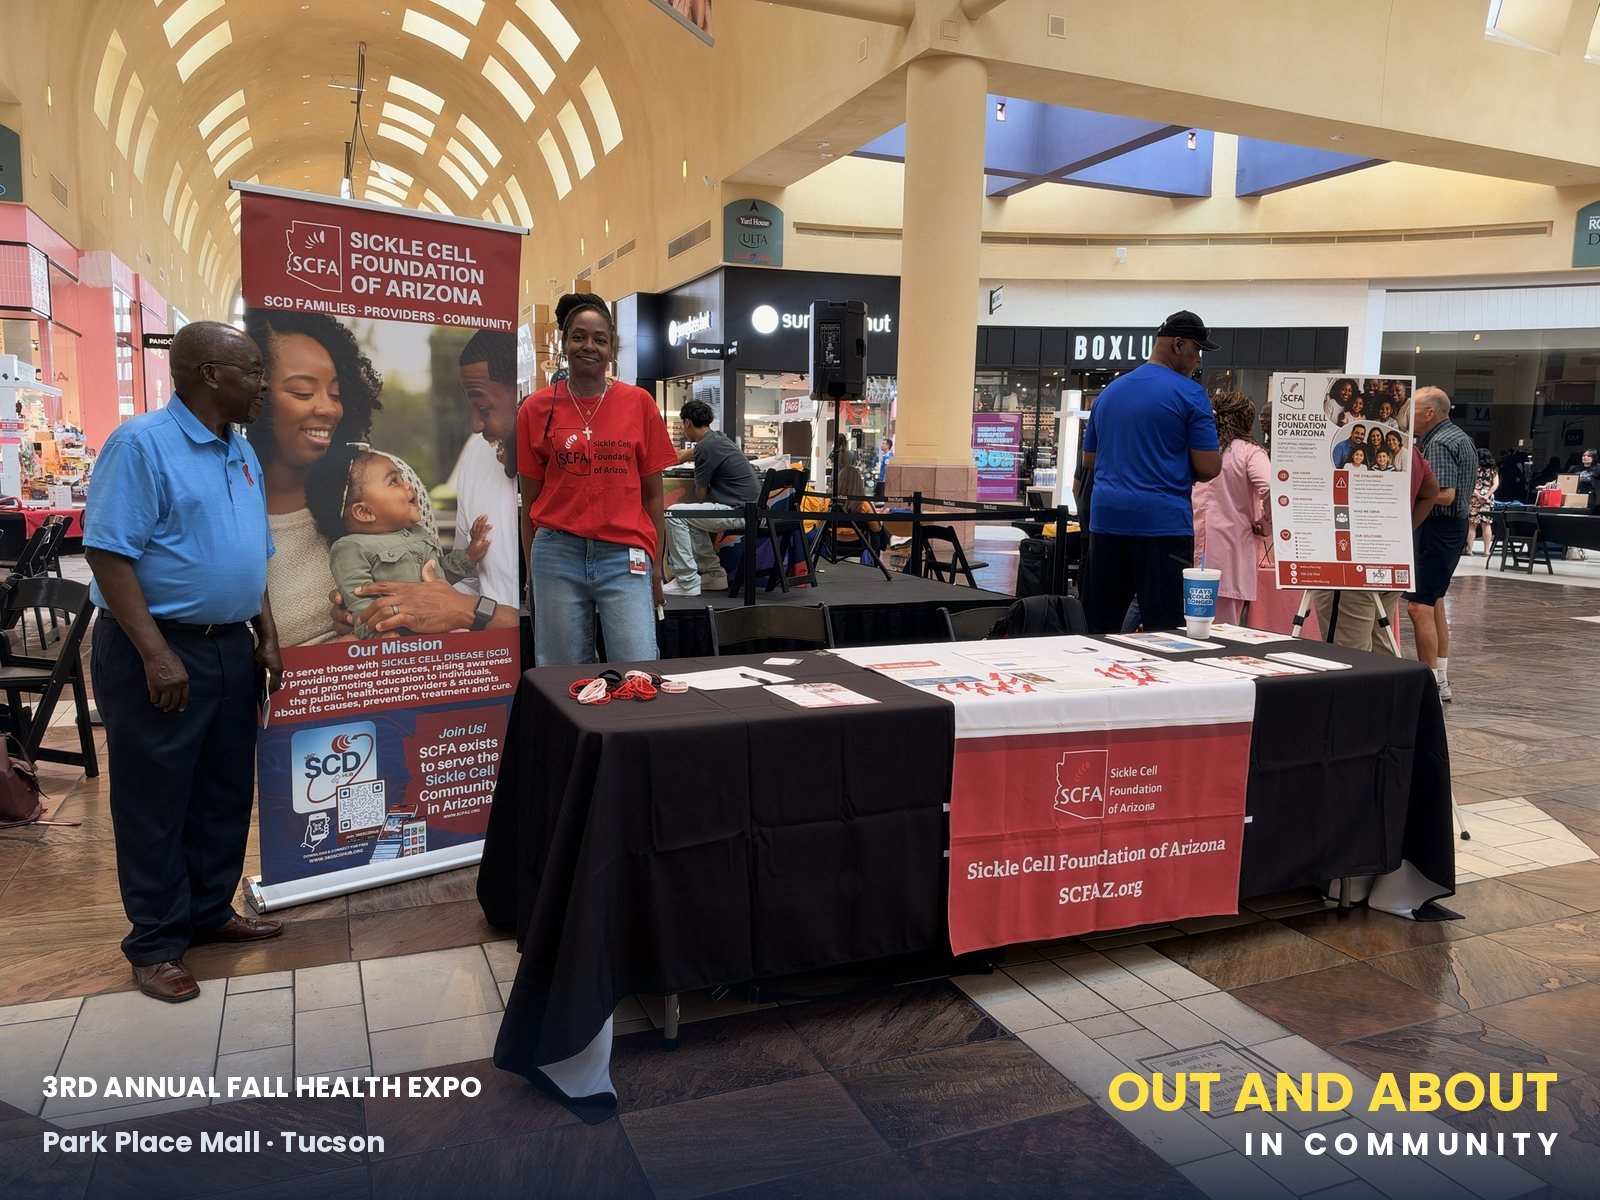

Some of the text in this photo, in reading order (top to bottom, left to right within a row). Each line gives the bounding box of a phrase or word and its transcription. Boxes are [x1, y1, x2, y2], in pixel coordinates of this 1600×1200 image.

[754, 218, 770, 226] House
[350, 231, 477, 264] SICKLE CELL
[742, 233, 768, 245] ULTA
[292, 255, 339, 276] SCFA
[351, 253, 484, 285] FOUNDATION
[351, 275, 483, 306] OF ARIZONA
[264, 295, 512, 331] SCD FAMILIES PROVIDERS COMMUNITY
[1074, 335, 1153, 360] BOXLU
[1283, 394, 1304, 402] SCFA
[1278, 413, 1328, 422] SICKLE CELL
[1278, 422, 1327, 430] FOUNDATION
[558, 452, 588, 464] SCFA
[348, 638, 442, 658] Our Mission
[290, 675, 338, 688] providing
[341, 670, 378, 681] needed
[381, 665, 430, 678] resources,
[432, 662, 464, 672] raising
[466, 658, 512, 668] awareness
[296, 668, 324, 677] serve
[326, 663, 354, 674] those
[356, 660, 378, 670] with
[381, 657, 416, 668] SICKLE
[418, 654, 442, 664] CELL
[444, 650, 484, 662] DISEASE
[486, 648, 509, 658] (SCD)
[290, 675, 499, 706] the public, healthcare providers & students
[298, 668, 492, 696] and promoting education to individuals,
[274, 682, 512, 718] about its causes, prevention, treatment and cure.
[439, 723, 487, 738] Join Us!
[420, 738, 498, 758] SCFA exists
[304, 752, 360, 778] SCD
[420, 752, 499, 772] to serve the
[1110, 765, 1158, 778] Sickle Cell
[426, 764, 494, 786] Sickle Cell
[420, 780, 498, 802] Community
[1060, 785, 1104, 804] SCFA
[1110, 782, 1162, 796] Foundation
[428, 794, 492, 814] in Arizona
[1108, 802, 1155, 815] of Arizona
[967, 838, 1226, 880] Sickle Cell Foundation of Arizona
[1058, 879, 1144, 904] SCFAZ.org
